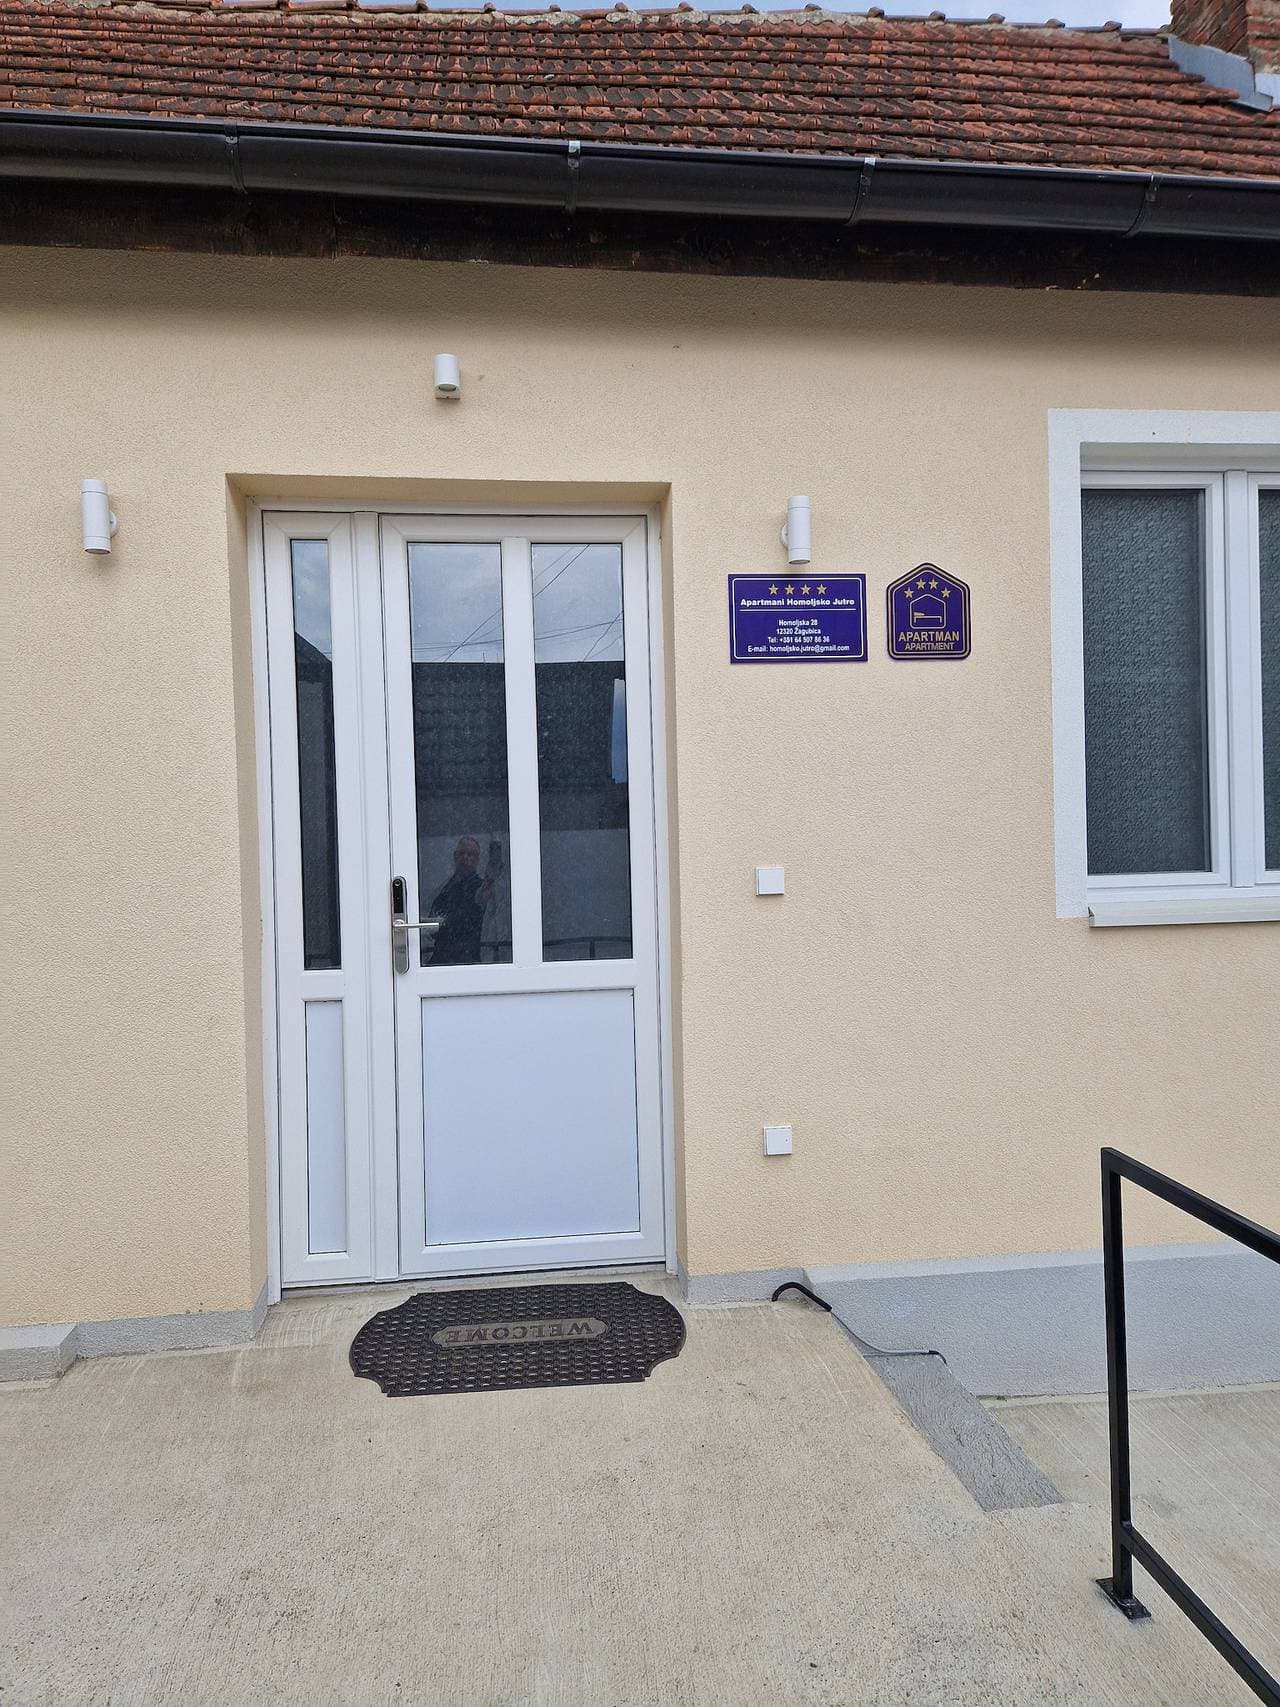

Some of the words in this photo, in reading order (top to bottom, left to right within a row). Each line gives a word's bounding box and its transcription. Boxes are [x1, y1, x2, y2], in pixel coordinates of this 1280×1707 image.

[740, 598, 785, 607] Apartmani
[786, 598, 831, 607] Homoljsko
[832, 598, 855, 606] Jutro
[898, 631, 960, 642] APARTMAN
[747, 645, 769, 653] E-mail:
[904, 642, 955, 651] APARTMENT
[446, 1321, 594, 1343] WELCOME
